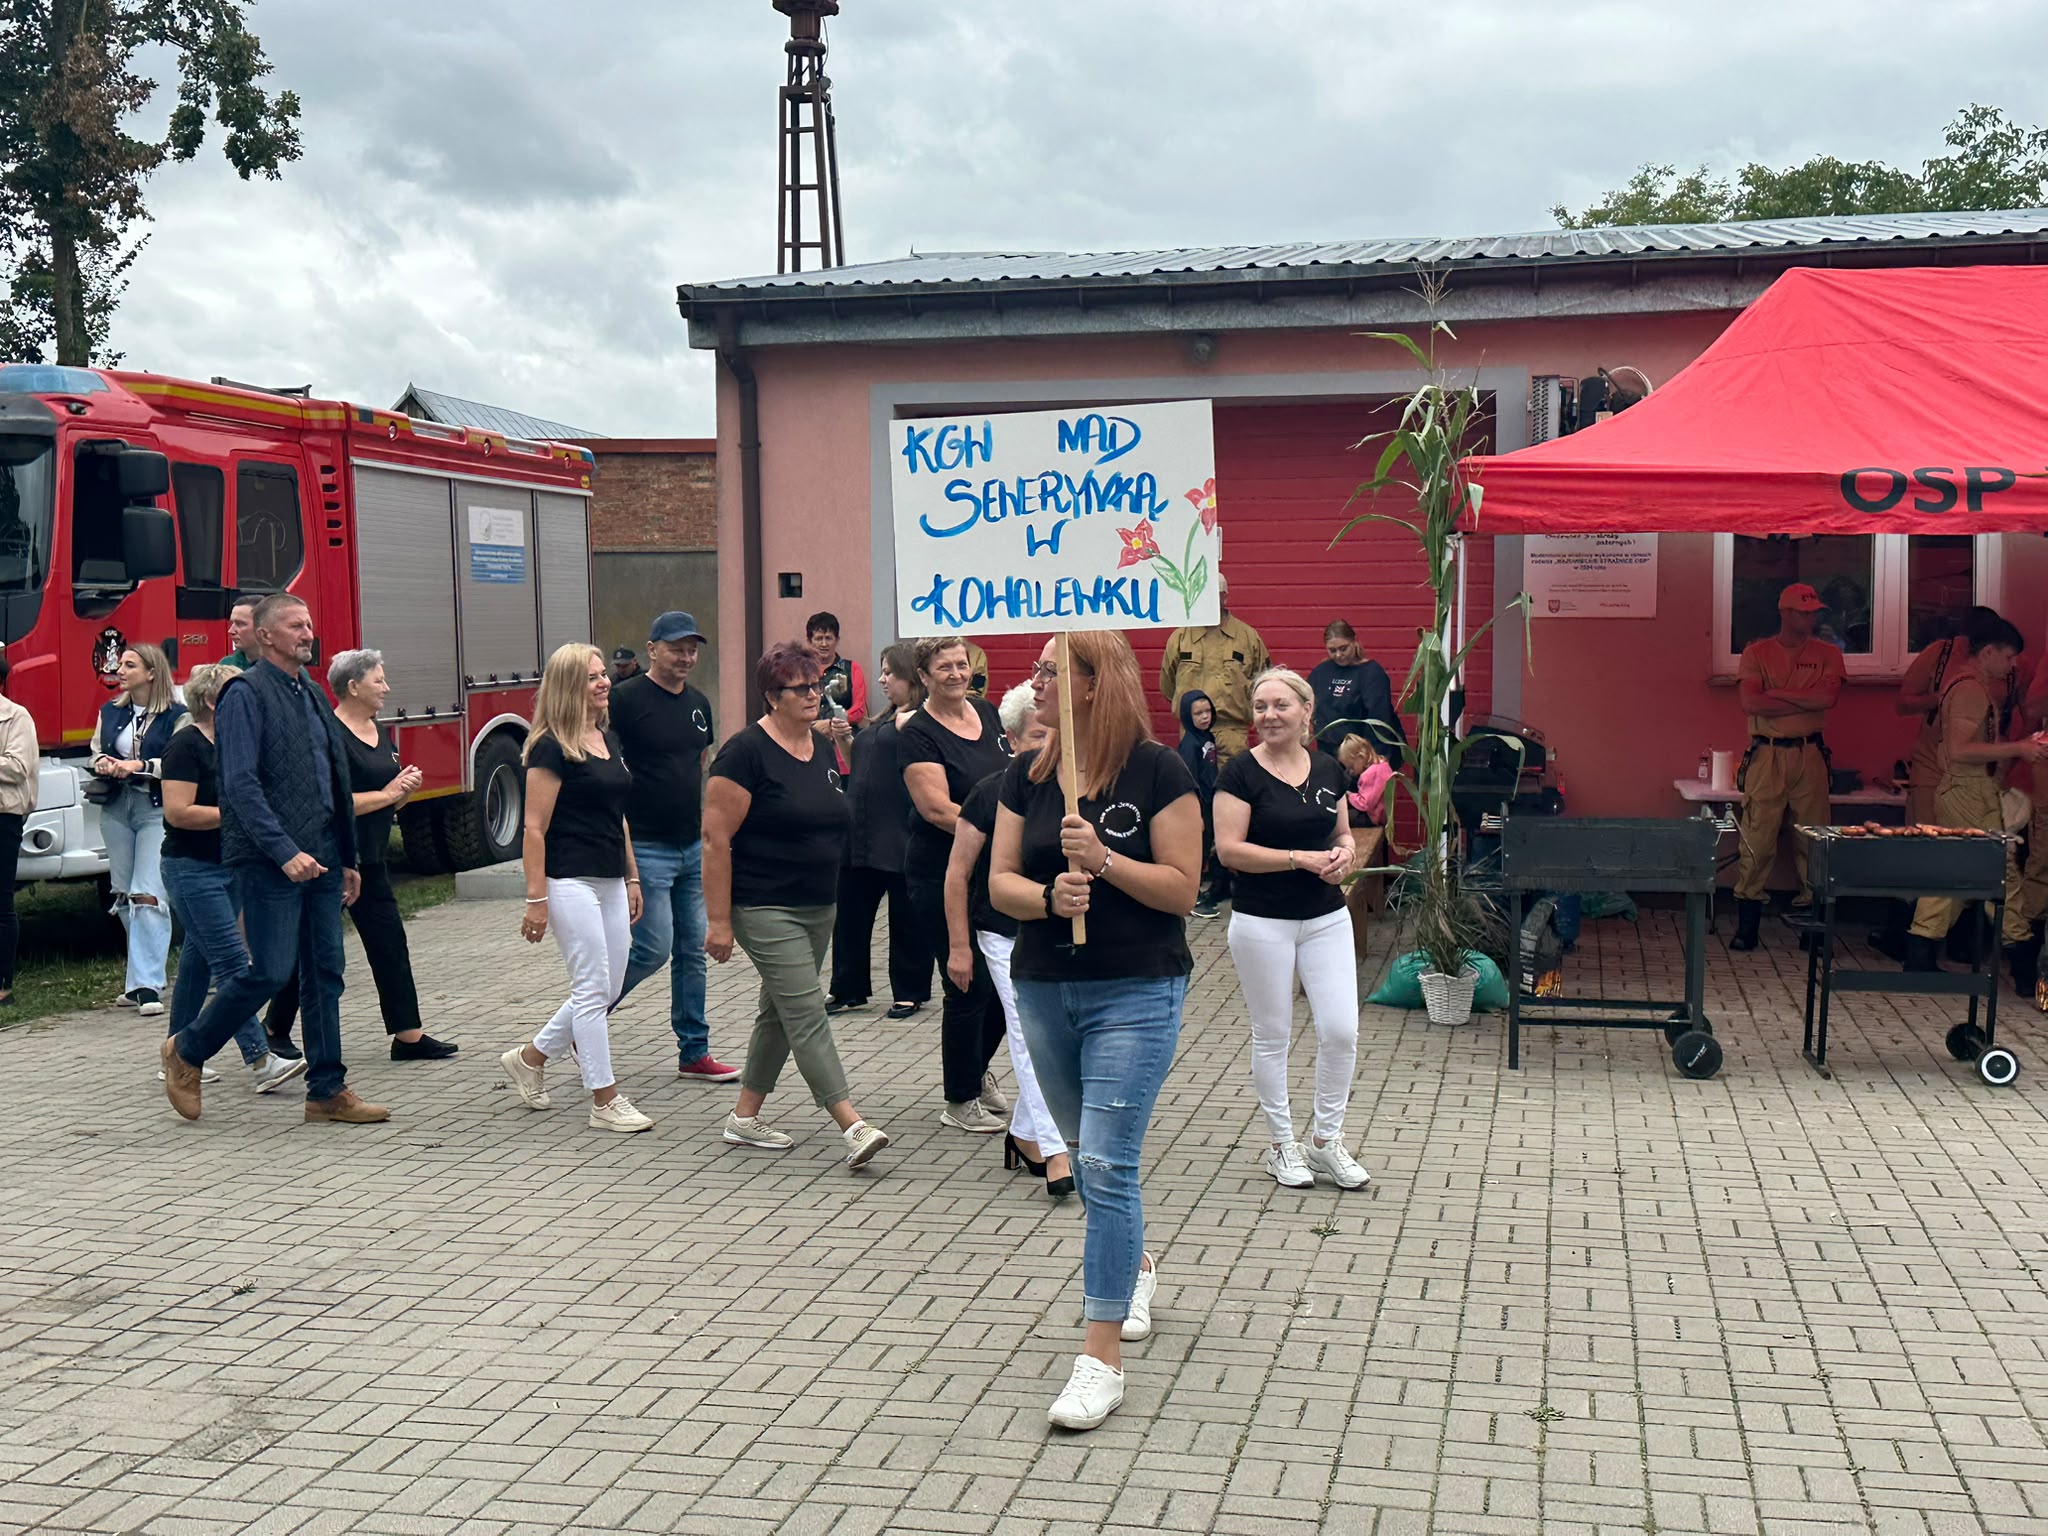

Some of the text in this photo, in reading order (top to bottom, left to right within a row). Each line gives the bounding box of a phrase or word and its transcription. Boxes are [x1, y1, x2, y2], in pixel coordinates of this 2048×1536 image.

[902, 414, 1141, 474] KGW NAD
[1840, 467, 2017, 514] OSP
[911, 573, 1165, 628] KOWALEWKU
